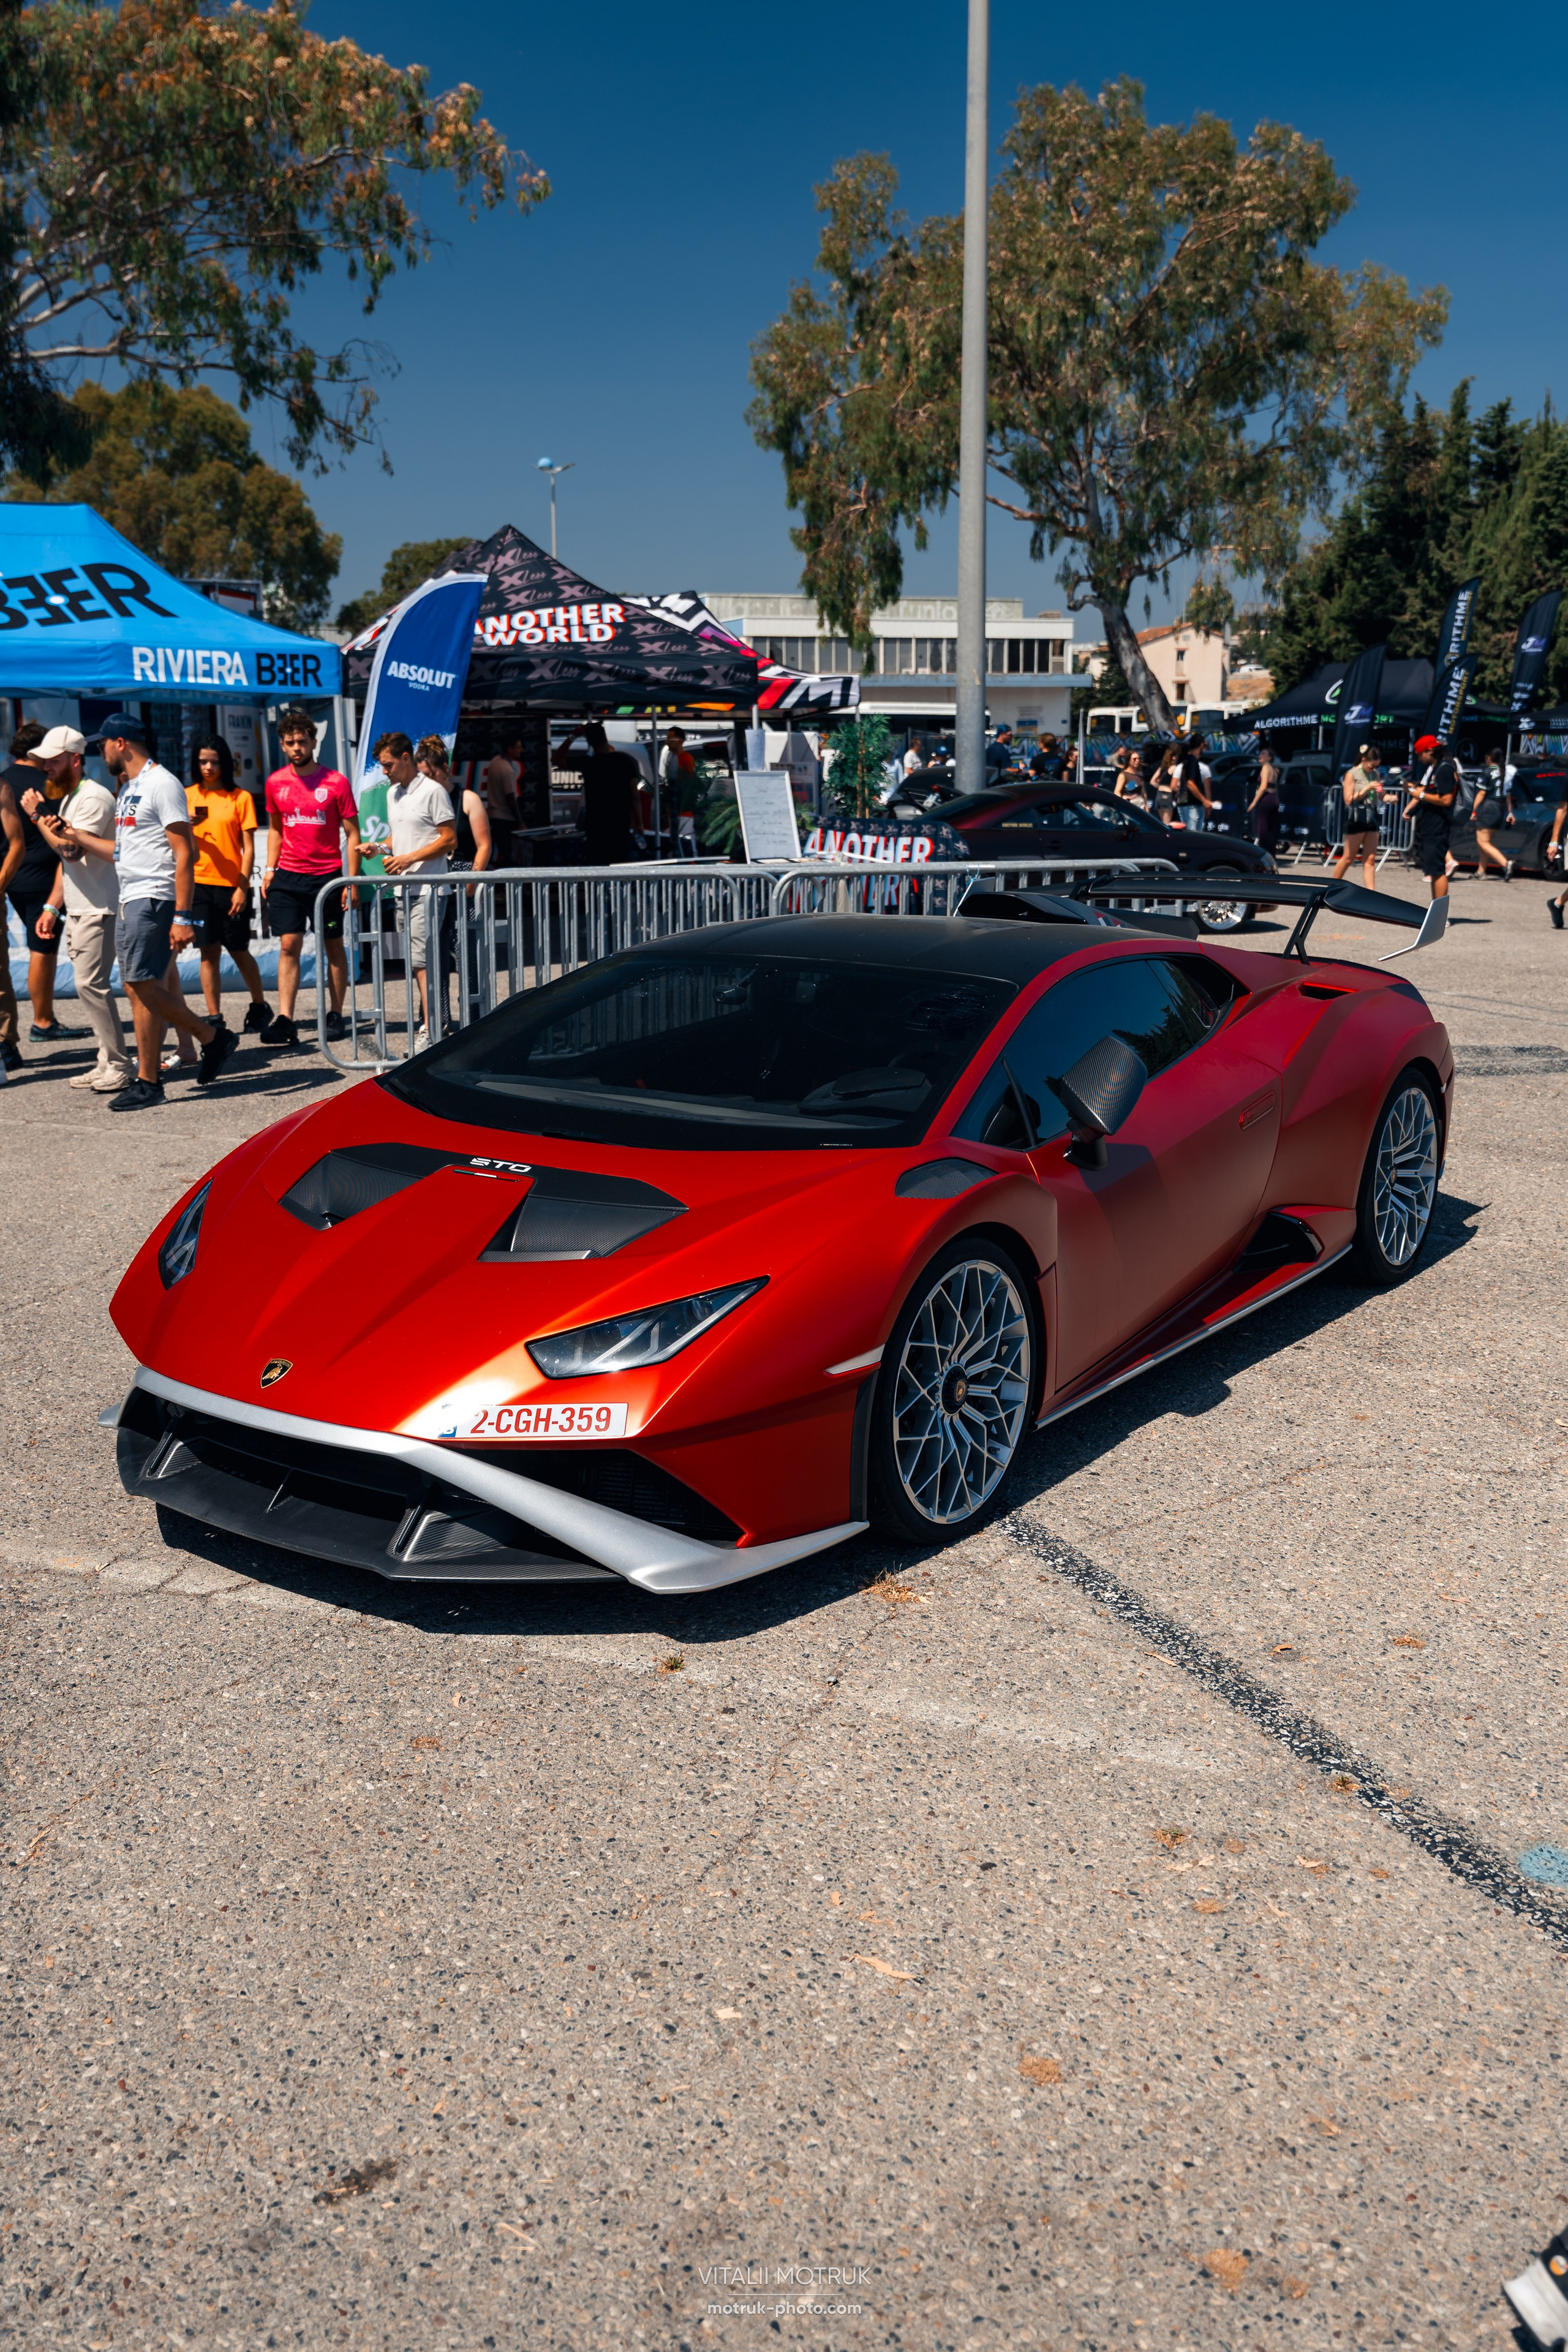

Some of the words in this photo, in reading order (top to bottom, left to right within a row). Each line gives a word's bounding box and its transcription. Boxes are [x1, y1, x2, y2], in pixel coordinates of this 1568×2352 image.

[1449, 590, 1470, 653] RITHME
[482, 624, 616, 646] WORLD
[132, 647, 249, 685] RIVIERA
[387, 661, 456, 688] ABSOLUT
[409, 682, 430, 692] VODKA
[1254, 714, 1318, 729] ALGORITHME
[282, 807, 326, 827] فلسطين
[803, 828, 933, 863] ANOTHER
[470, 1158, 532, 1172] STO
[470, 1407, 612, 1434] 2-CGH-359
